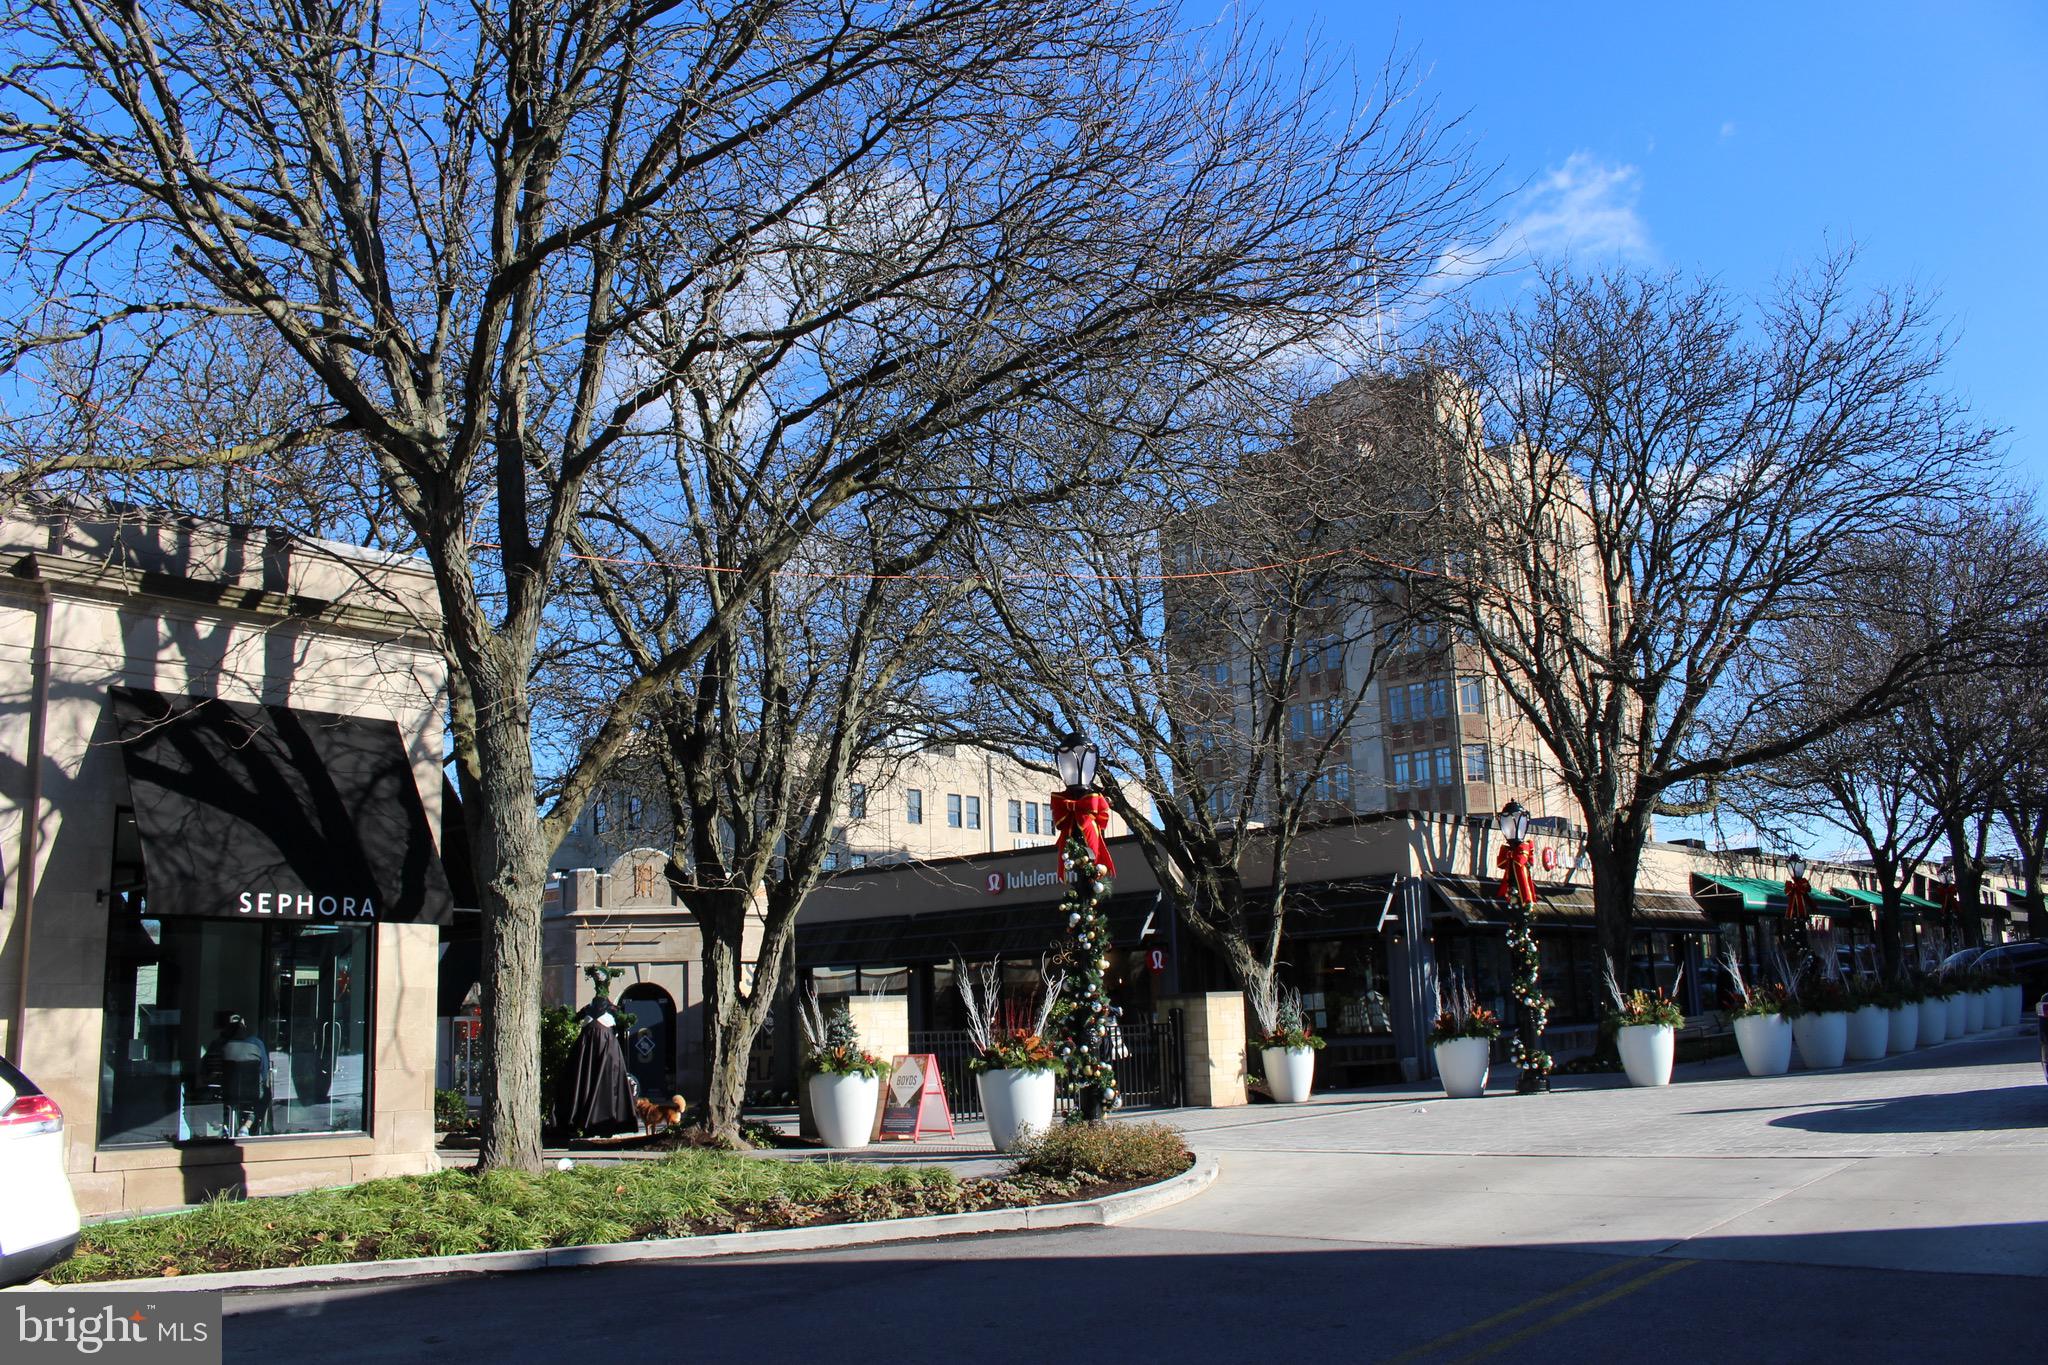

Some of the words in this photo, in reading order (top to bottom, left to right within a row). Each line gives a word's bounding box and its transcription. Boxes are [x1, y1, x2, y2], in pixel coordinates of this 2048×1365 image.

[1007, 869, 1078, 889] lululemn
[239, 891, 375, 917] SEPHORA
[896, 1075, 918, 1086] BOYDS
